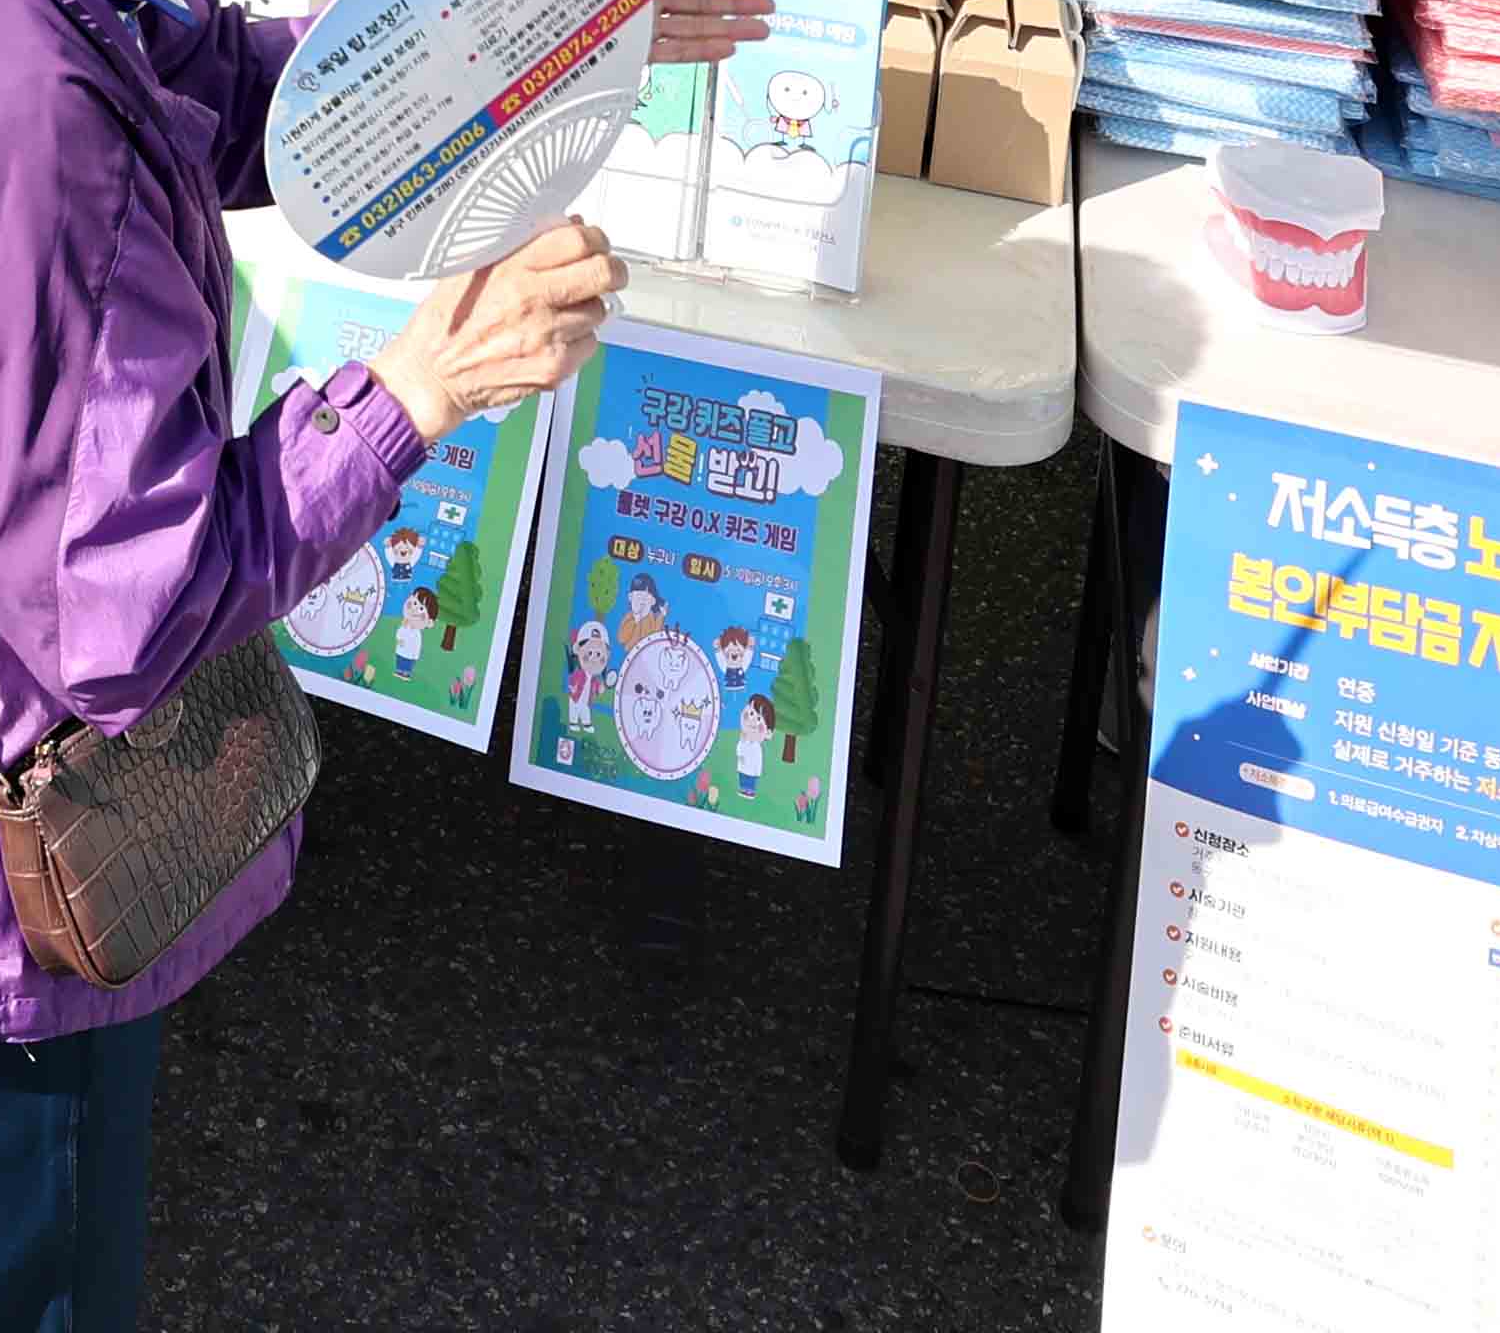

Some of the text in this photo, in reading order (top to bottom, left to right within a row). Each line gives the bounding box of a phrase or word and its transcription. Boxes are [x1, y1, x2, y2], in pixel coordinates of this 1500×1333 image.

[641, 386, 799, 456] 구강 퀴즈 풀고
[441, 442, 475, 471] 게임
[706, 444, 781, 505] 받고!
[653, 498, 688, 528] 구강
[724, 514, 759, 544] 퀴즈
[763, 522, 798, 553] 게임
[1267, 472, 1459, 570] 저소득층
[612, 538, 676, 566] 대상 누구나
[1228, 552, 1462, 666] 본인부담금
[1248, 651, 1376, 703] 사업기간 연중
[1334, 709, 1375, 738] 지원
[1378, 720, 1436, 754] 신청일
[1440, 735, 1480, 764] 기준
[1333, 738, 1391, 772] 실제로
[1395, 755, 1472, 793] 거주하는
[1192, 827, 1250, 859] 신청장소
[1187, 888, 1247, 920] 시술기관
[1184, 930, 1243, 964] 지원내용
[1180, 974, 1240, 1007] 시술비용
